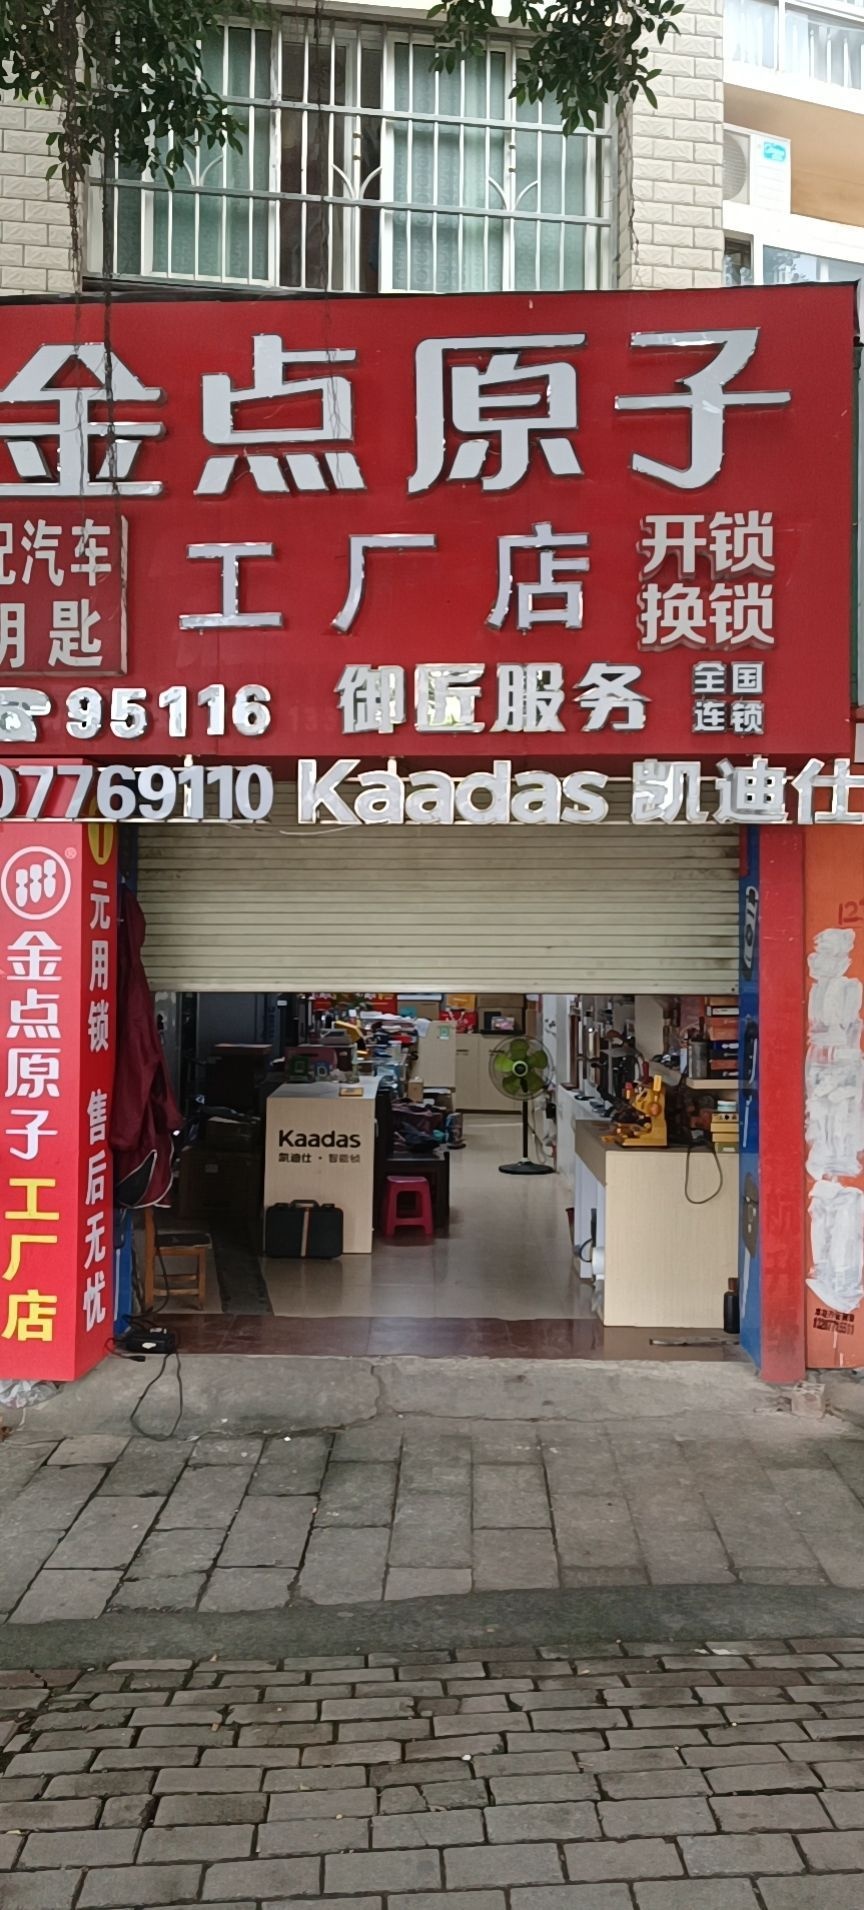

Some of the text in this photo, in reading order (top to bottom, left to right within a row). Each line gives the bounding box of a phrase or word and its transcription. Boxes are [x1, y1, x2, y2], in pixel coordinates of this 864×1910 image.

[0, 328, 791, 498] 金点原子
[641, 510, 776, 574] 开锁
[179, 521, 591, 632] 工厂店
[640, 582, 776, 645] 换锁
[334, 662, 652, 734] 御匠服务
[692, 660, 764, 694] 全国
[65, 684, 271, 739] 95116
[692, 700, 764, 735] 连锁
[297, 756, 864, 825] Kaadas 凯迪仕
[2, 931, 63, 1342] 金点原子 工厂店
[278, 1129, 361, 1148] Kaadas
[83, 1089, 108, 1332] 售后无忧
